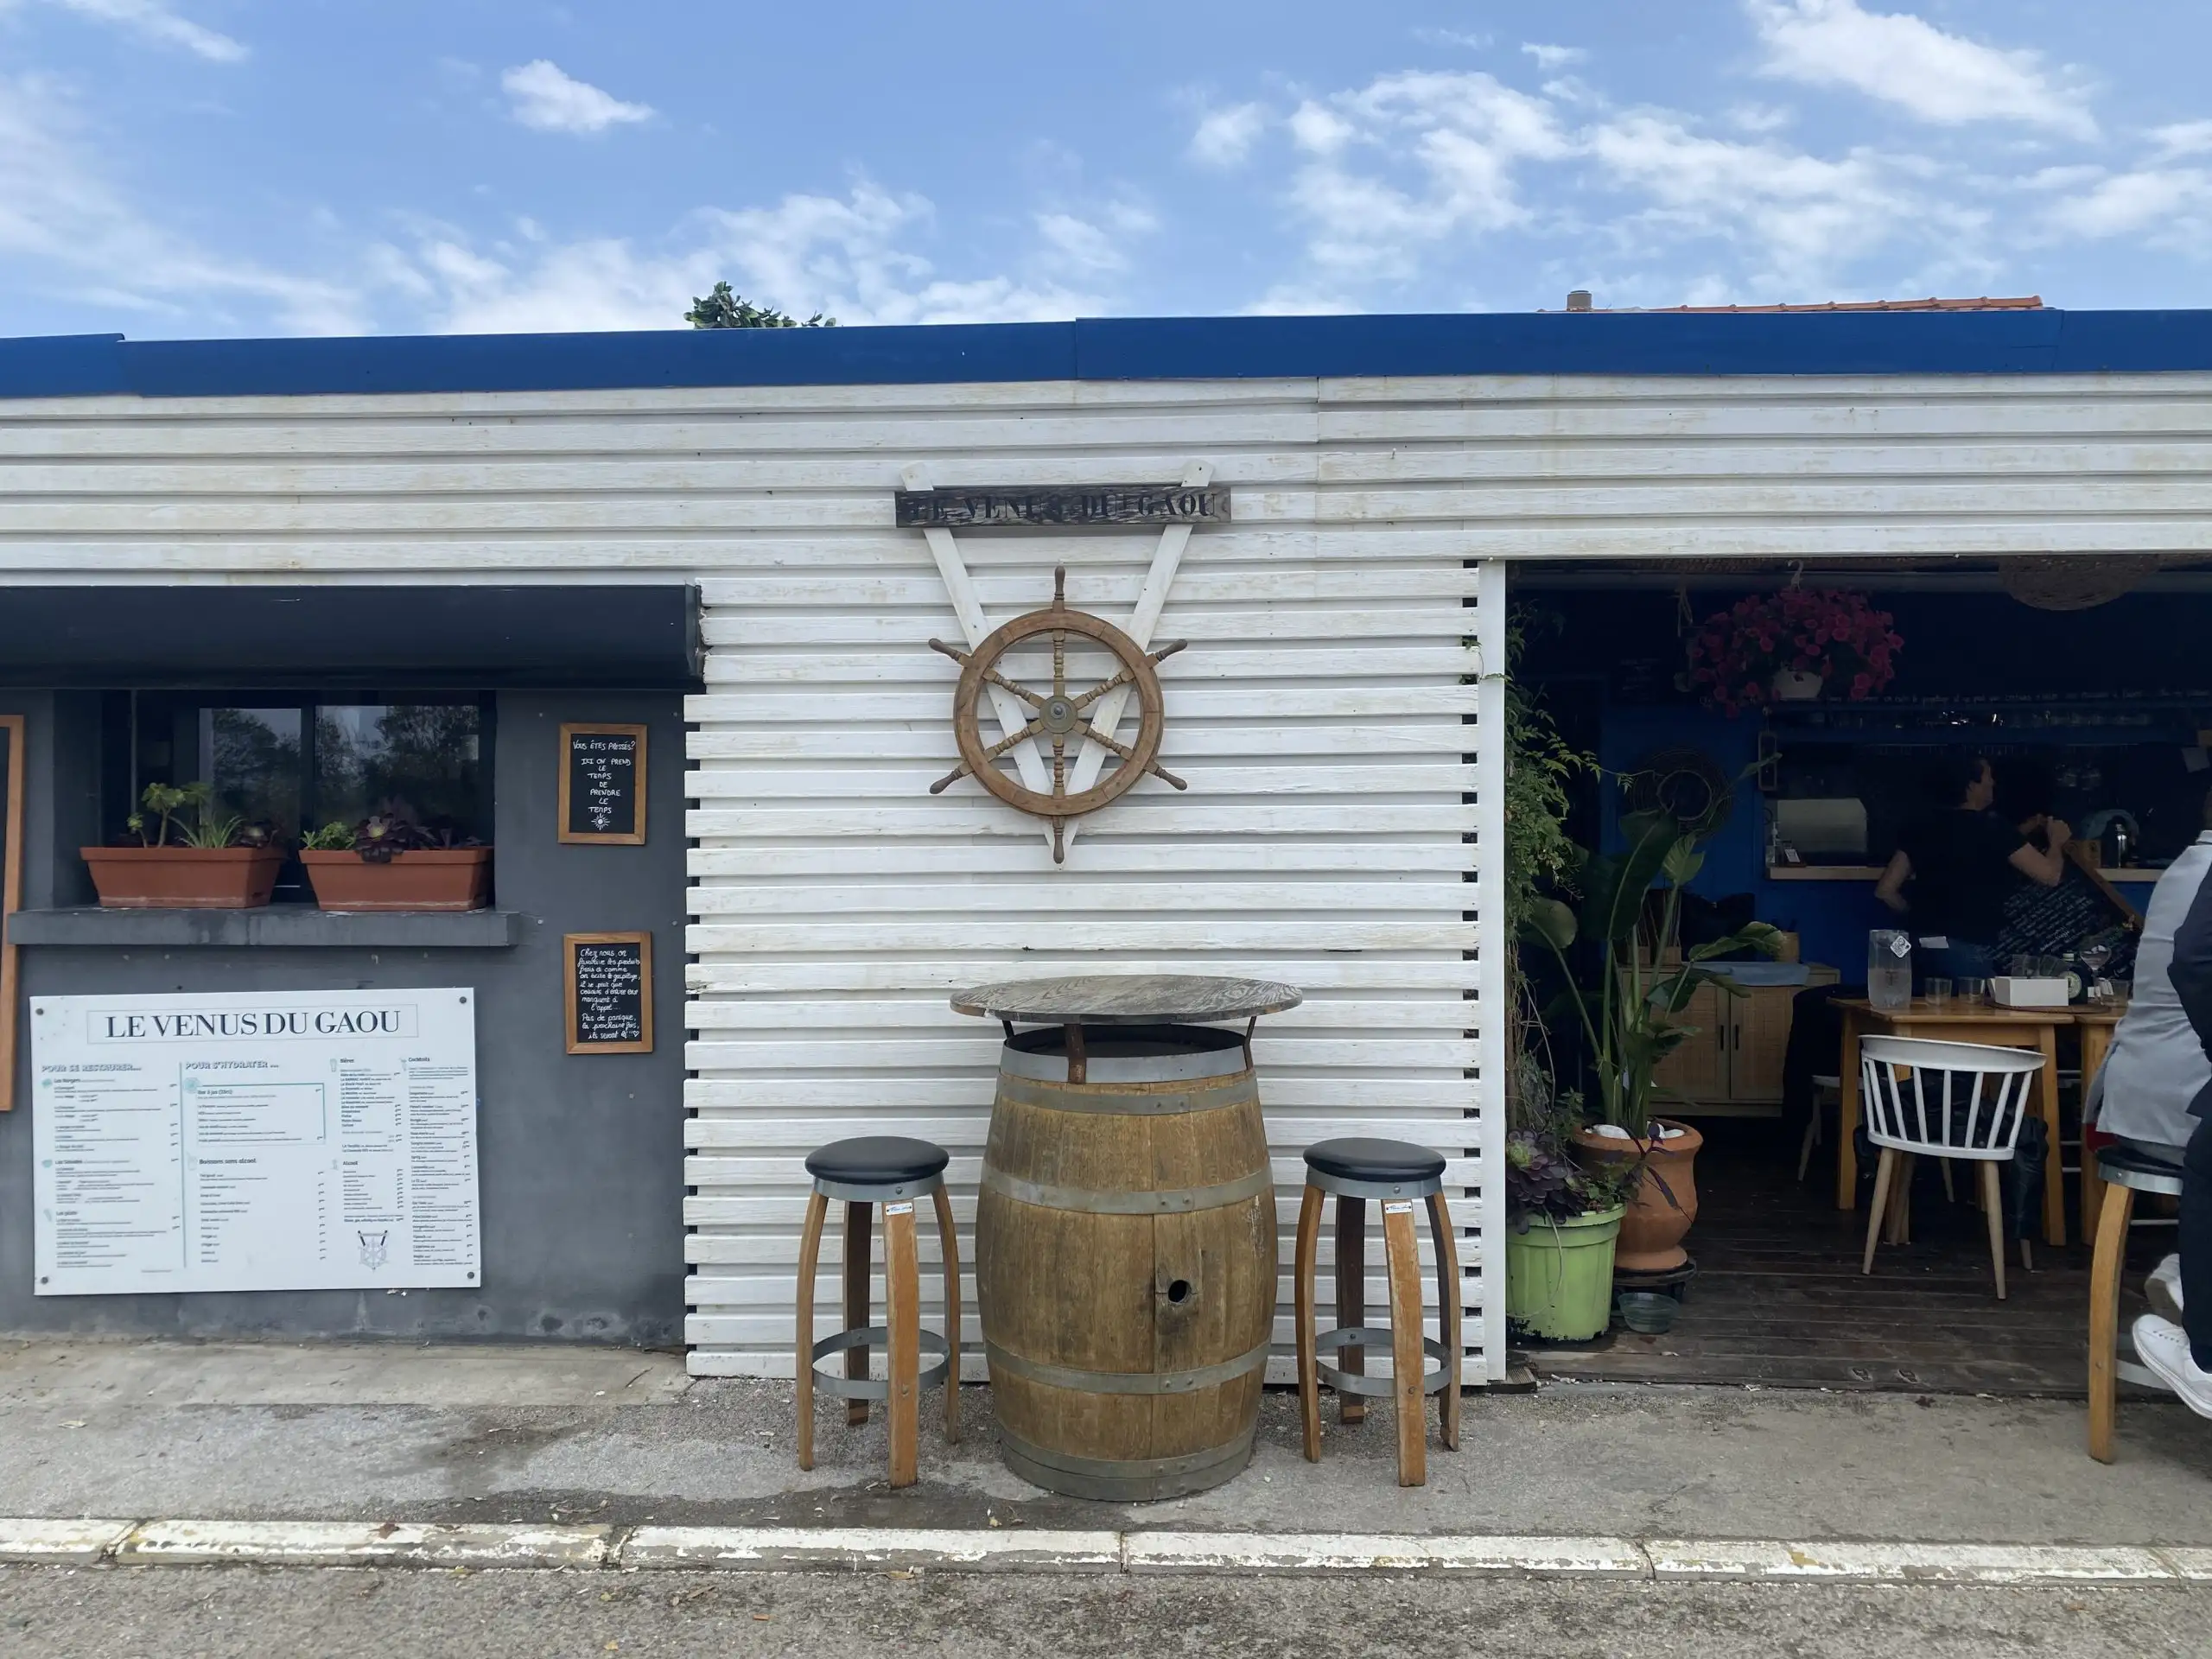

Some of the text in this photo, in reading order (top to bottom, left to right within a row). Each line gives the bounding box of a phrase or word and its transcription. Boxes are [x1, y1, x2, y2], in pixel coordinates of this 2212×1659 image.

[1138, 493, 1217, 517] GAOU
[590, 741, 606, 750] ÊTES
[580, 948, 598, 957] Chez
[105, 1010, 401, 1038] LE VENUS DU GAOU
[213, 1061, 268, 1070] S'HYDRATER
